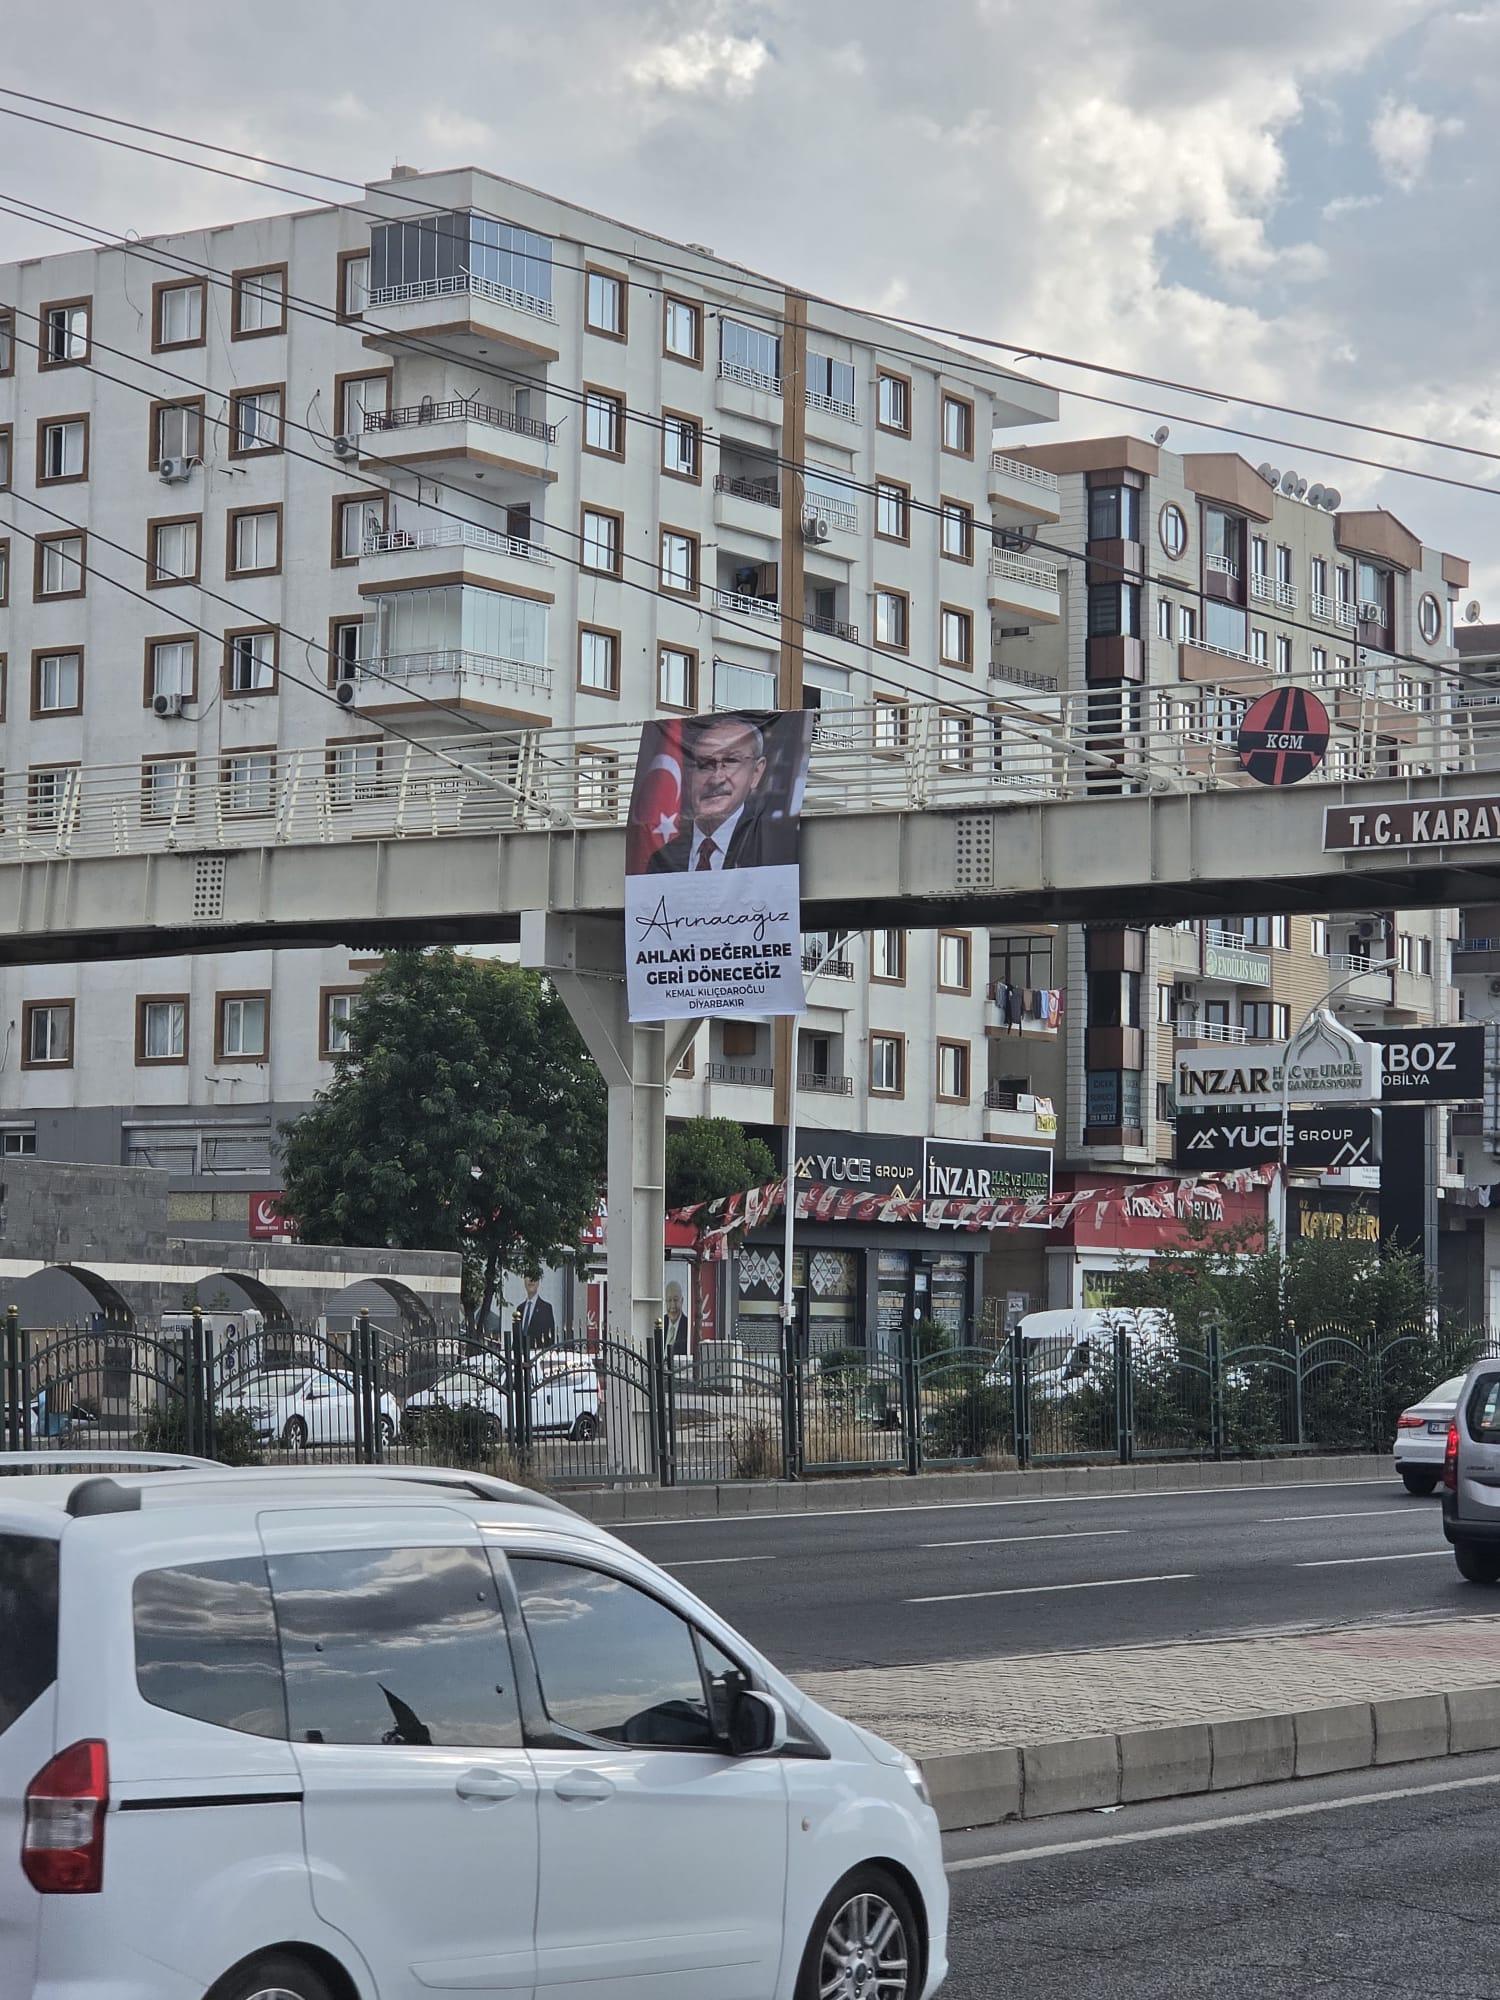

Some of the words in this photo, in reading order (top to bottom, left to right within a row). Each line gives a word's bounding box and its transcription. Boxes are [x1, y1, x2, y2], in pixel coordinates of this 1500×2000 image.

[1265, 733, 1304, 750] KGM
[1349, 813, 1401, 845] T.C.
[635, 895, 789, 942] Arınacağız
[636, 944, 695, 964] AHLAKİ
[700, 942, 792, 961] DEĞERLERE
[646, 966, 683, 985] GERİ
[688, 961, 781, 982] DÖNECEĞİZ
[1217, 953, 1248, 980] ENDÜLÜS
[665, 988, 695, 998] KEMAL
[698, 985, 765, 998] KILIÇDAROĞLU
[689, 998, 744, 1009] DİYARBAKIR
[1381, 1042, 1457, 1072] BOZ
[1179, 1061, 1271, 1097] İNZAR
[1381, 1072, 1431, 1087] OBİLYA
[1298, 1129, 1353, 1142] GROUP
[875, 1165, 914, 1179] GROUP
[928, 1155, 992, 1198] İNZAR
[991, 1170, 1010, 1186] HAC
[1021, 1172, 1048, 1188] UMRE
